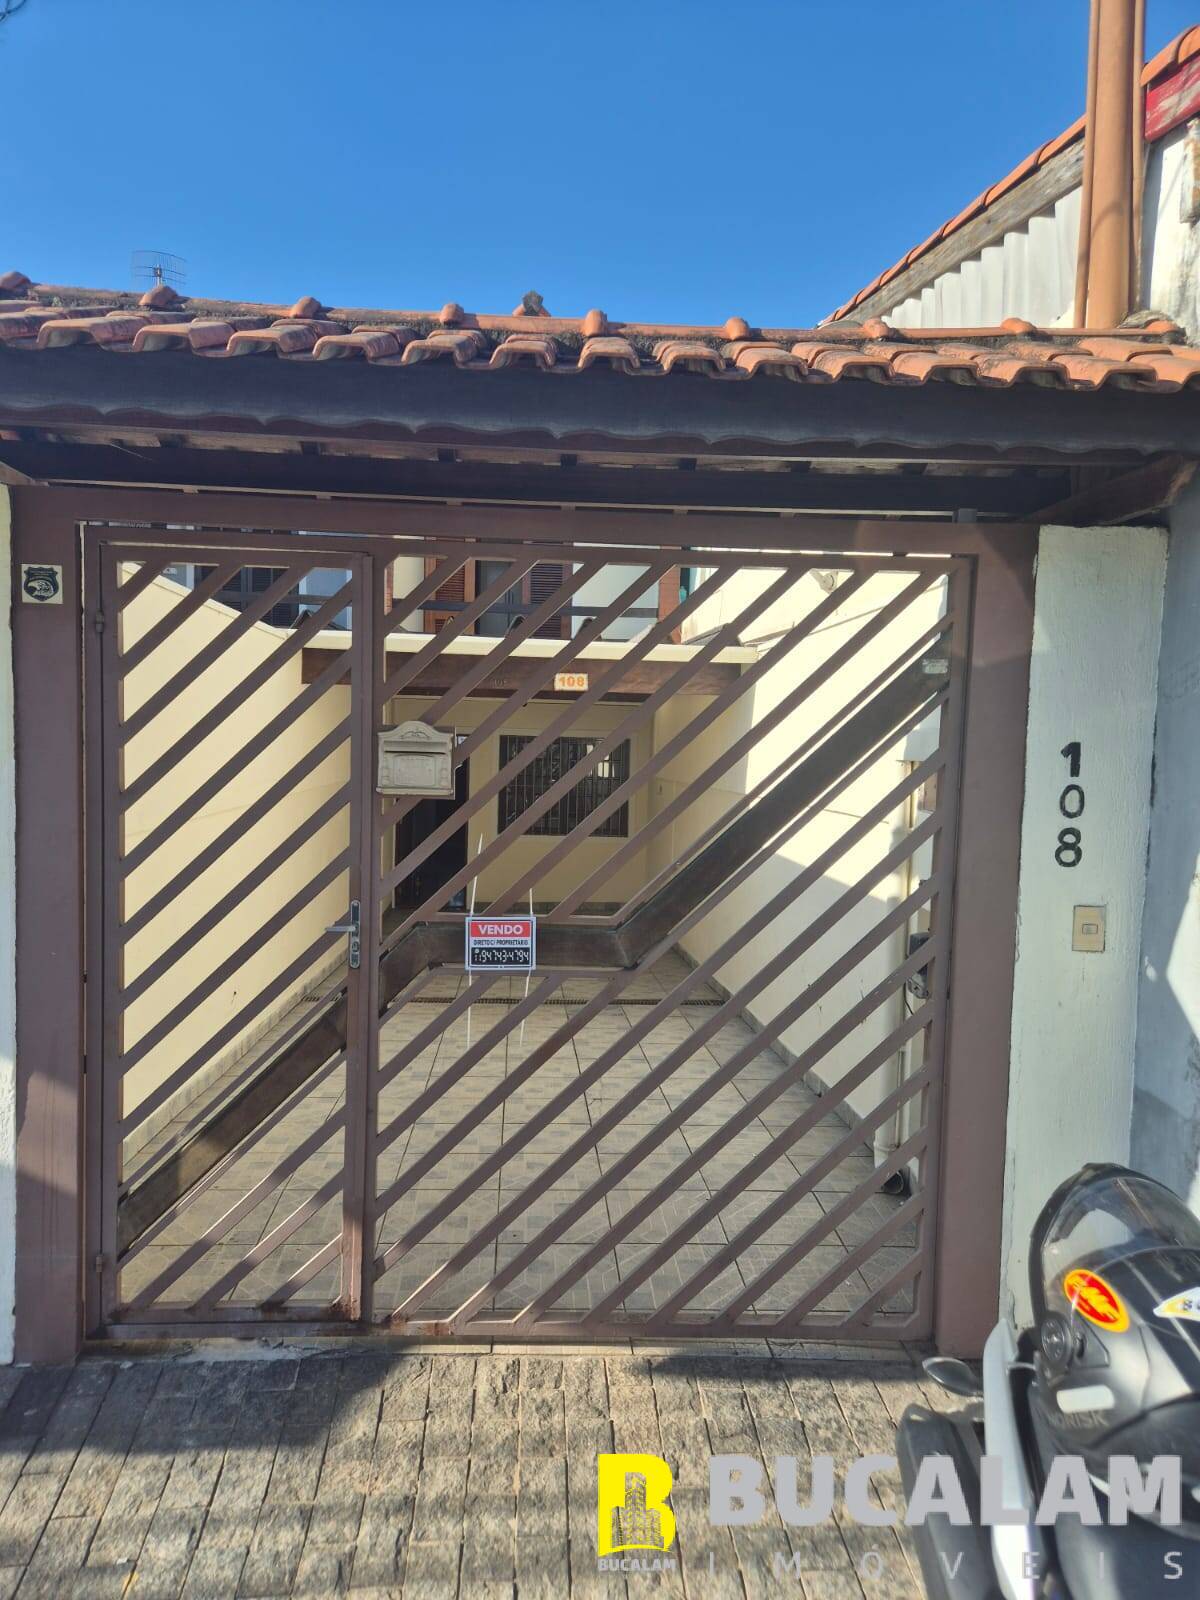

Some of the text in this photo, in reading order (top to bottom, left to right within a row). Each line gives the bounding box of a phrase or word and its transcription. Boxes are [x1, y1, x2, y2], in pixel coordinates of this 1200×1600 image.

[559, 676, 585, 687] 108
[1055, 742, 1085, 867] 108
[479, 925, 523, 934] VENDO
